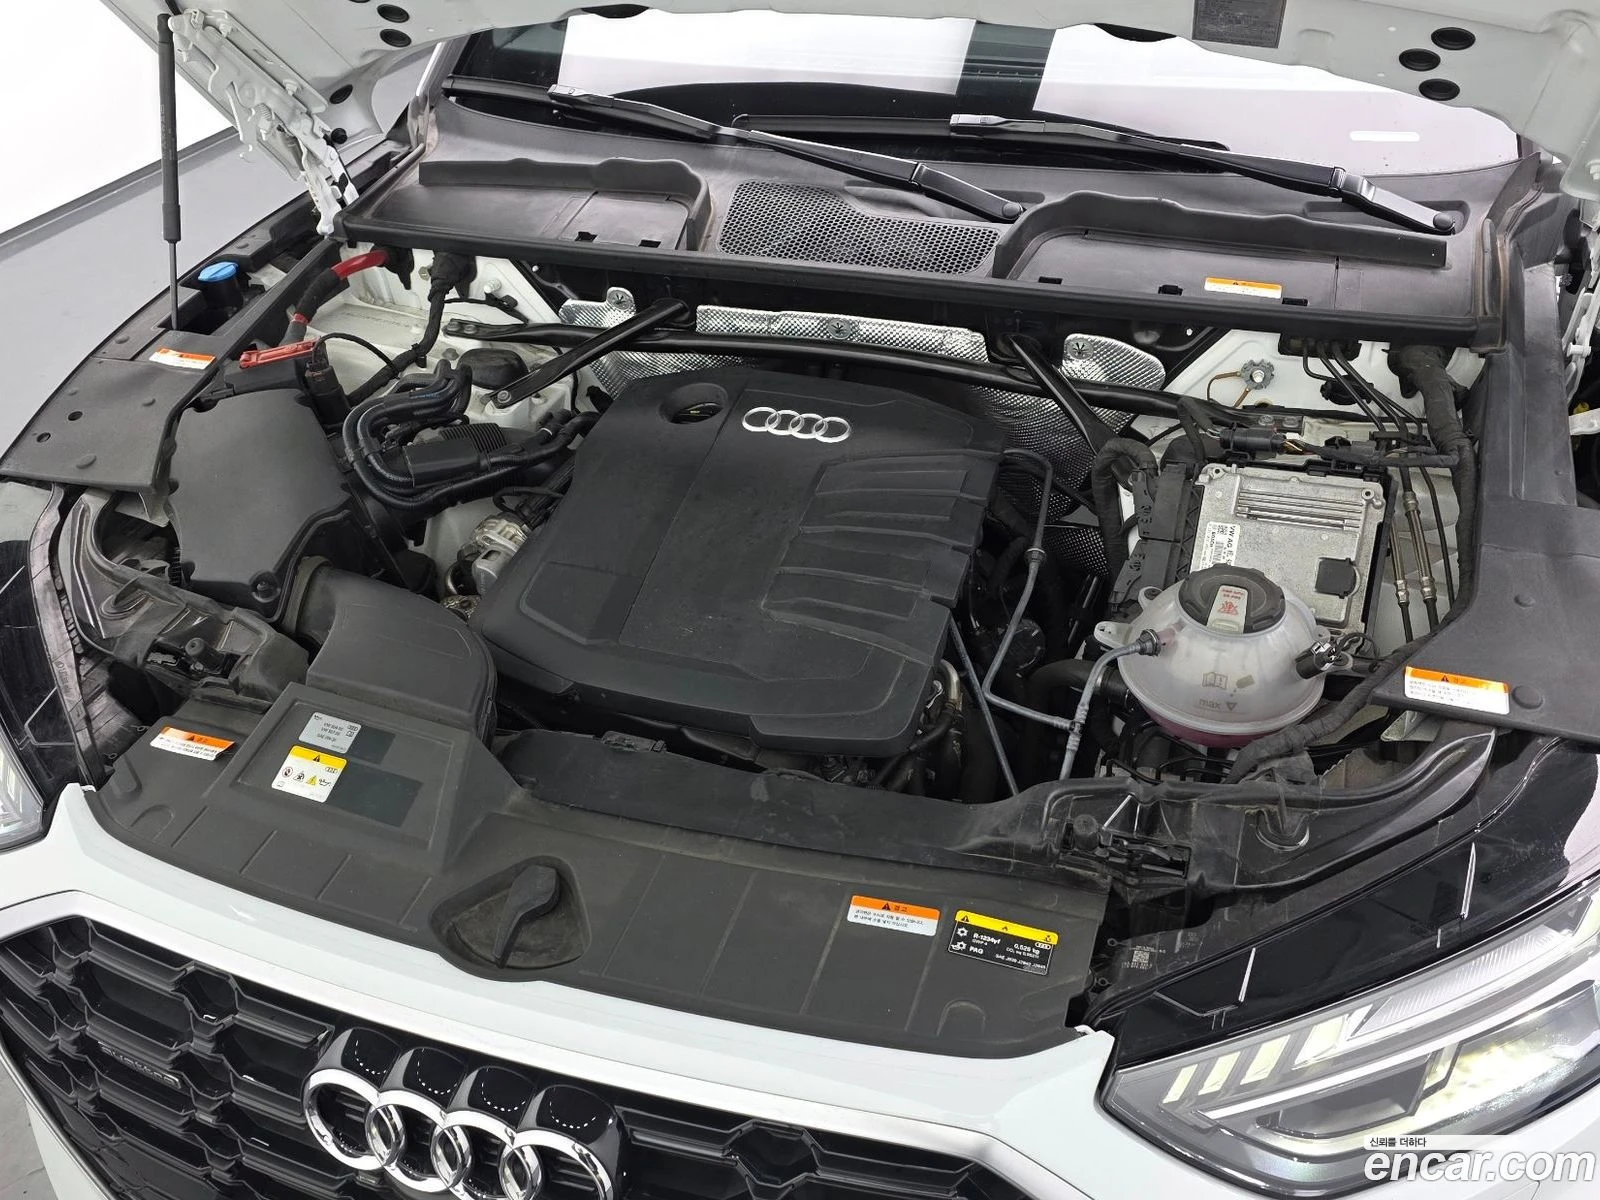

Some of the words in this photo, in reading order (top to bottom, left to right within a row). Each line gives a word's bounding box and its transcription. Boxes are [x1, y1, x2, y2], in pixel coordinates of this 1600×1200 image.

[1199, 699, 1221, 709] max
[973, 932, 1001, 944] R-1234yf
[969, 946, 984, 954] PAG
[101, 1045, 175, 1086] quattro
